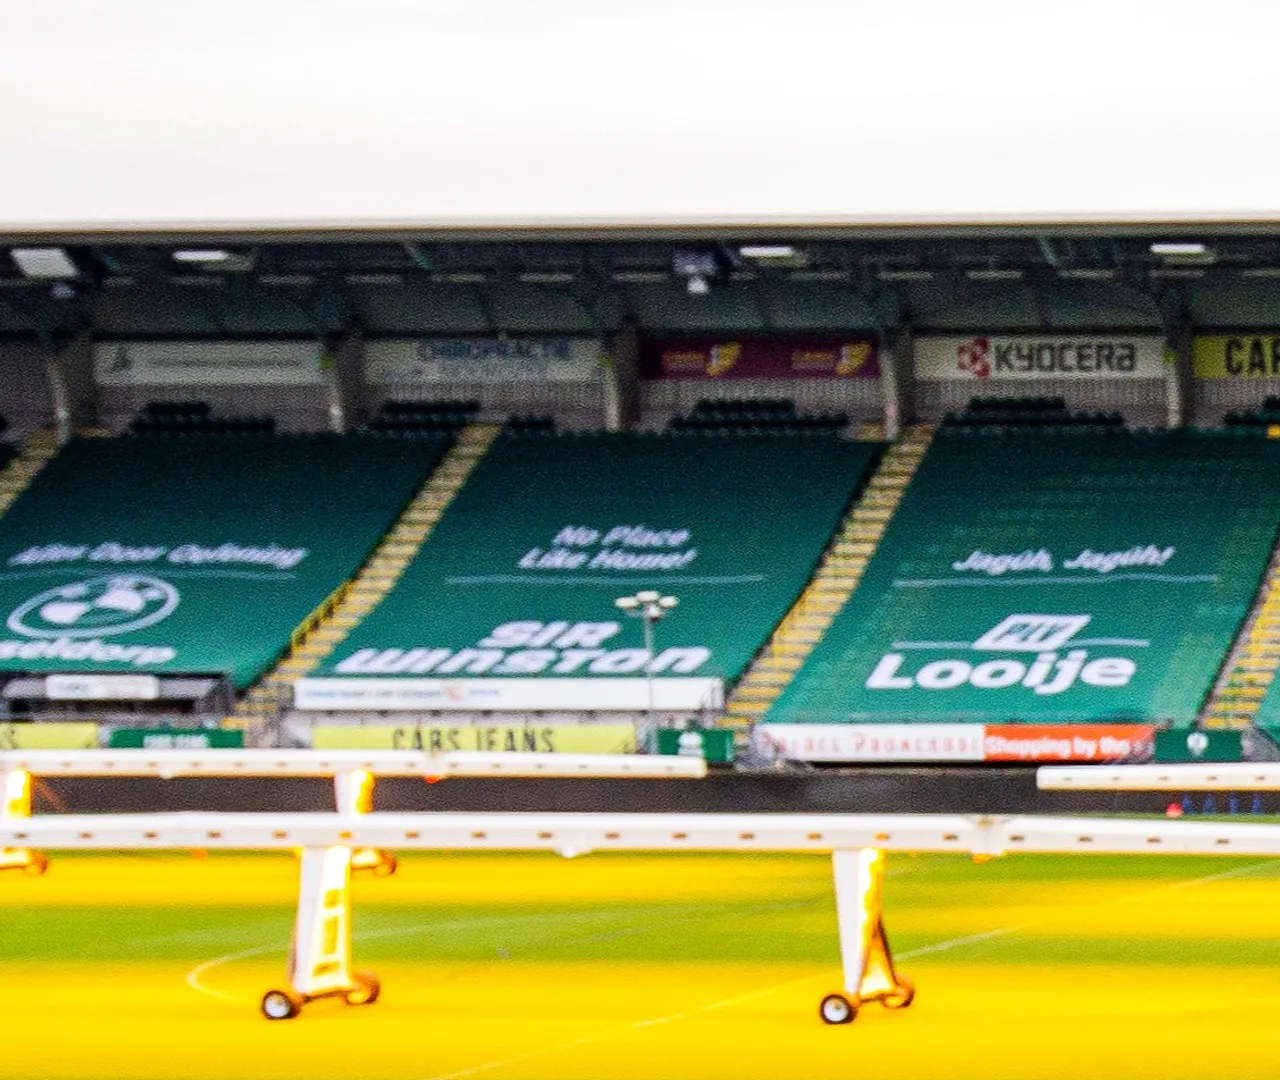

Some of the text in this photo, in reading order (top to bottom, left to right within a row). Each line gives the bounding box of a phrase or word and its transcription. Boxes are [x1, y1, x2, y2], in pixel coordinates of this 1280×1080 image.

[478, 620, 621, 648] SIR
[865, 649, 1137, 696] Looije
[392, 728, 461, 752] CARS
